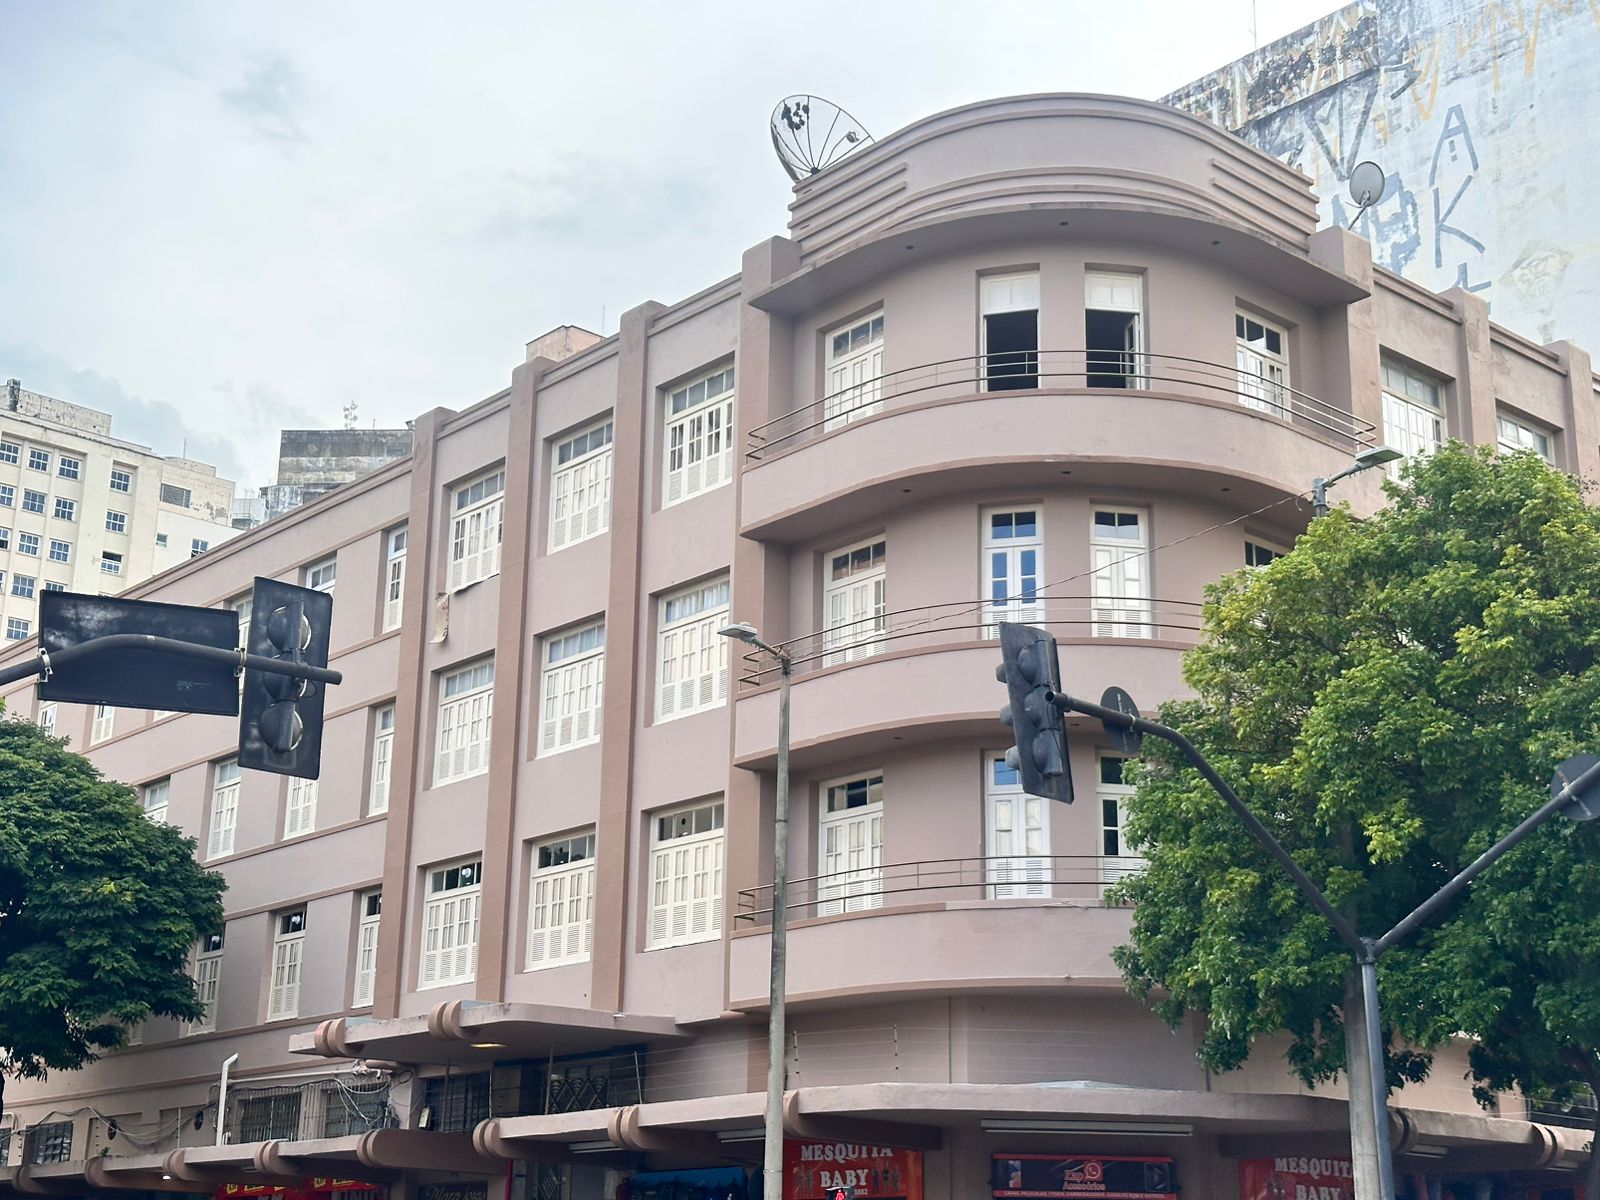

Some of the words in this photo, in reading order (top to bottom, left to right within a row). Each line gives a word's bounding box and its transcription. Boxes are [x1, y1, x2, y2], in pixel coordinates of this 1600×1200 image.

[801, 1143, 894, 1163] MESQUITA
[1274, 1157, 1353, 1180] MESQUIT
[820, 1169, 869, 1188] BABY
[1295, 1184, 1341, 1200] BABY
